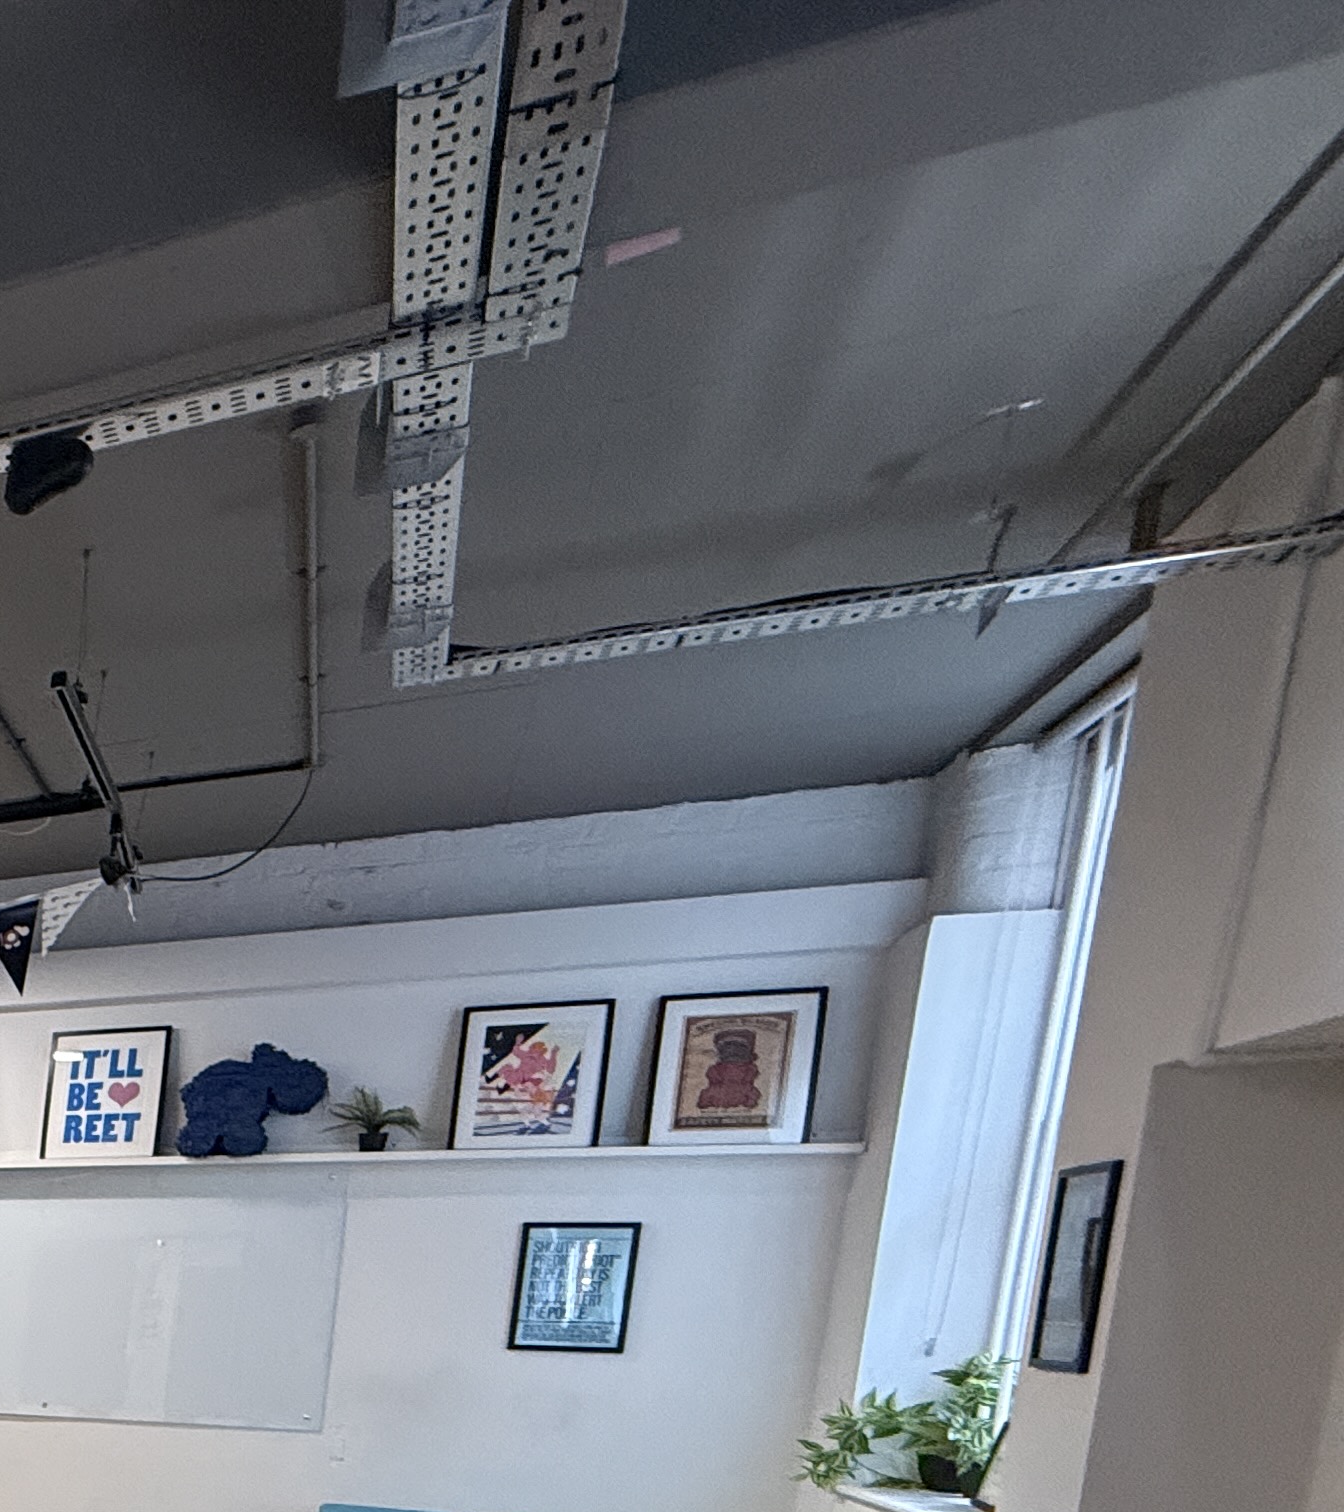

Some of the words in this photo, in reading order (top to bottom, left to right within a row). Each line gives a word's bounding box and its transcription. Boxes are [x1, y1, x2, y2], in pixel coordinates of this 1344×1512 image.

[71, 1048, 143, 1080] IT'LL
[67, 1082, 104, 1111] BE
[62, 1112, 142, 1143] REET
